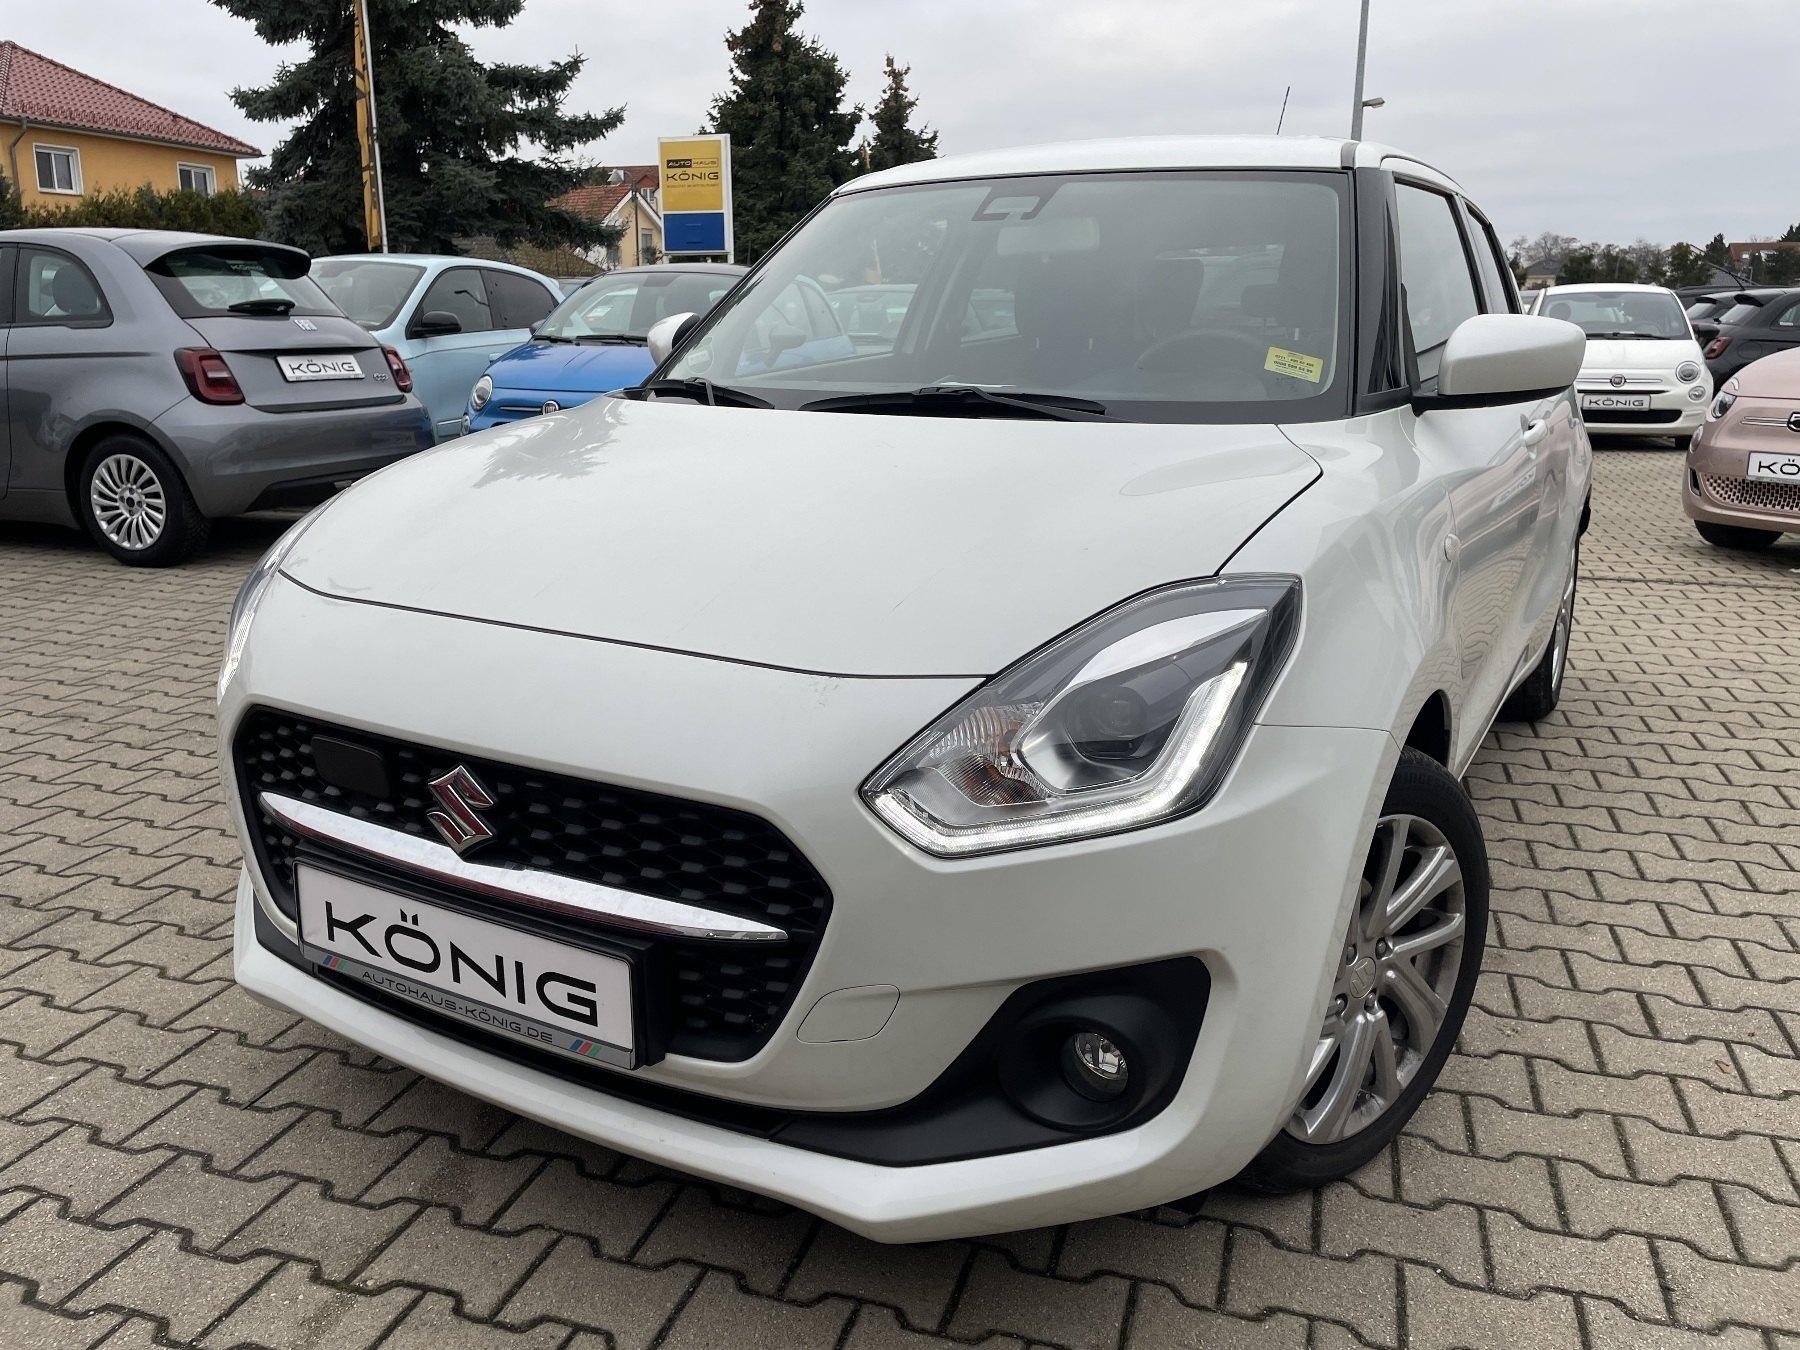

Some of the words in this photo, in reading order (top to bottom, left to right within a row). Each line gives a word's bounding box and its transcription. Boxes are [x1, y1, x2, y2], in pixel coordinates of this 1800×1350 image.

[667, 160, 691, 168] AUTO
[666, 170, 719, 182] KÖNIG
[288, 358, 356, 374] KÖNIG
[1588, 396, 1644, 407] KÖNIG
[324, 900, 598, 1027] KÖNIG
[361, 970, 553, 1042] AUTOHAUS-KÖNIG.DE
